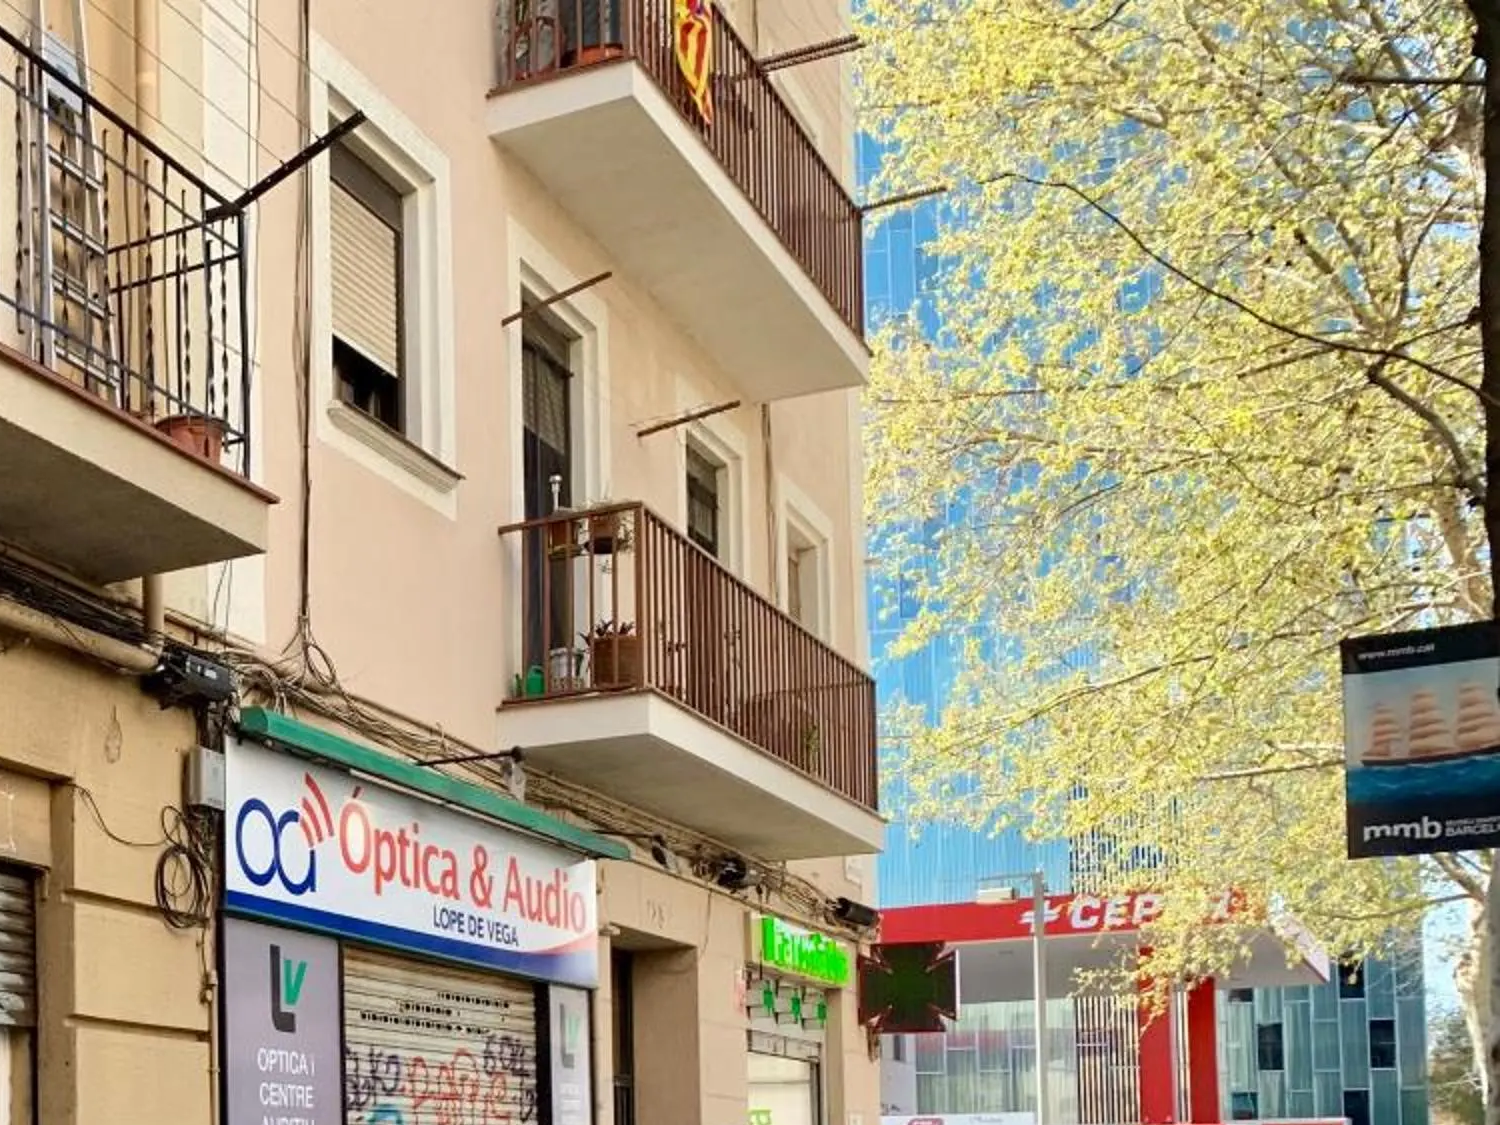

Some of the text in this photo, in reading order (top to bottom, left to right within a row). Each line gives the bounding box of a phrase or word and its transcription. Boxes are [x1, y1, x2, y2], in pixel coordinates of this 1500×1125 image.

[1362, 815, 1443, 843] mmb
[338, 785, 460, 896] Óptica
[469, 844, 494, 909] &
[503, 856, 587, 933] Audio
[433, 904, 520, 948] LOPE DE VEGA
[1069, 888, 1234, 930] CEPA
[259, 1082, 314, 1109] CENTRE
